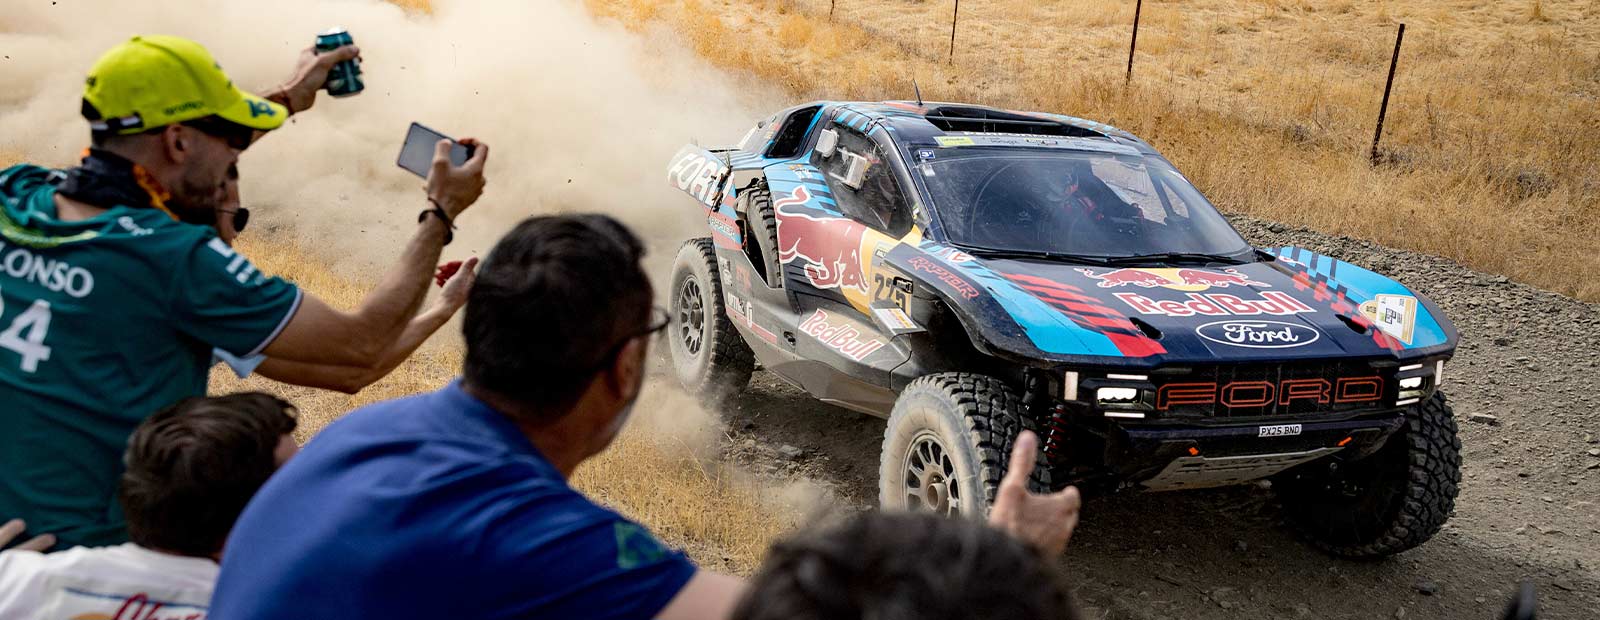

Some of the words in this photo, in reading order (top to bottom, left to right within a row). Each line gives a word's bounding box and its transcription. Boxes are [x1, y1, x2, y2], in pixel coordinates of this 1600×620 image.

[908, 256, 979, 301] RAPTOR
[1223, 323, 1299, 343] Ford
[1157, 376, 1385, 410] FORD
